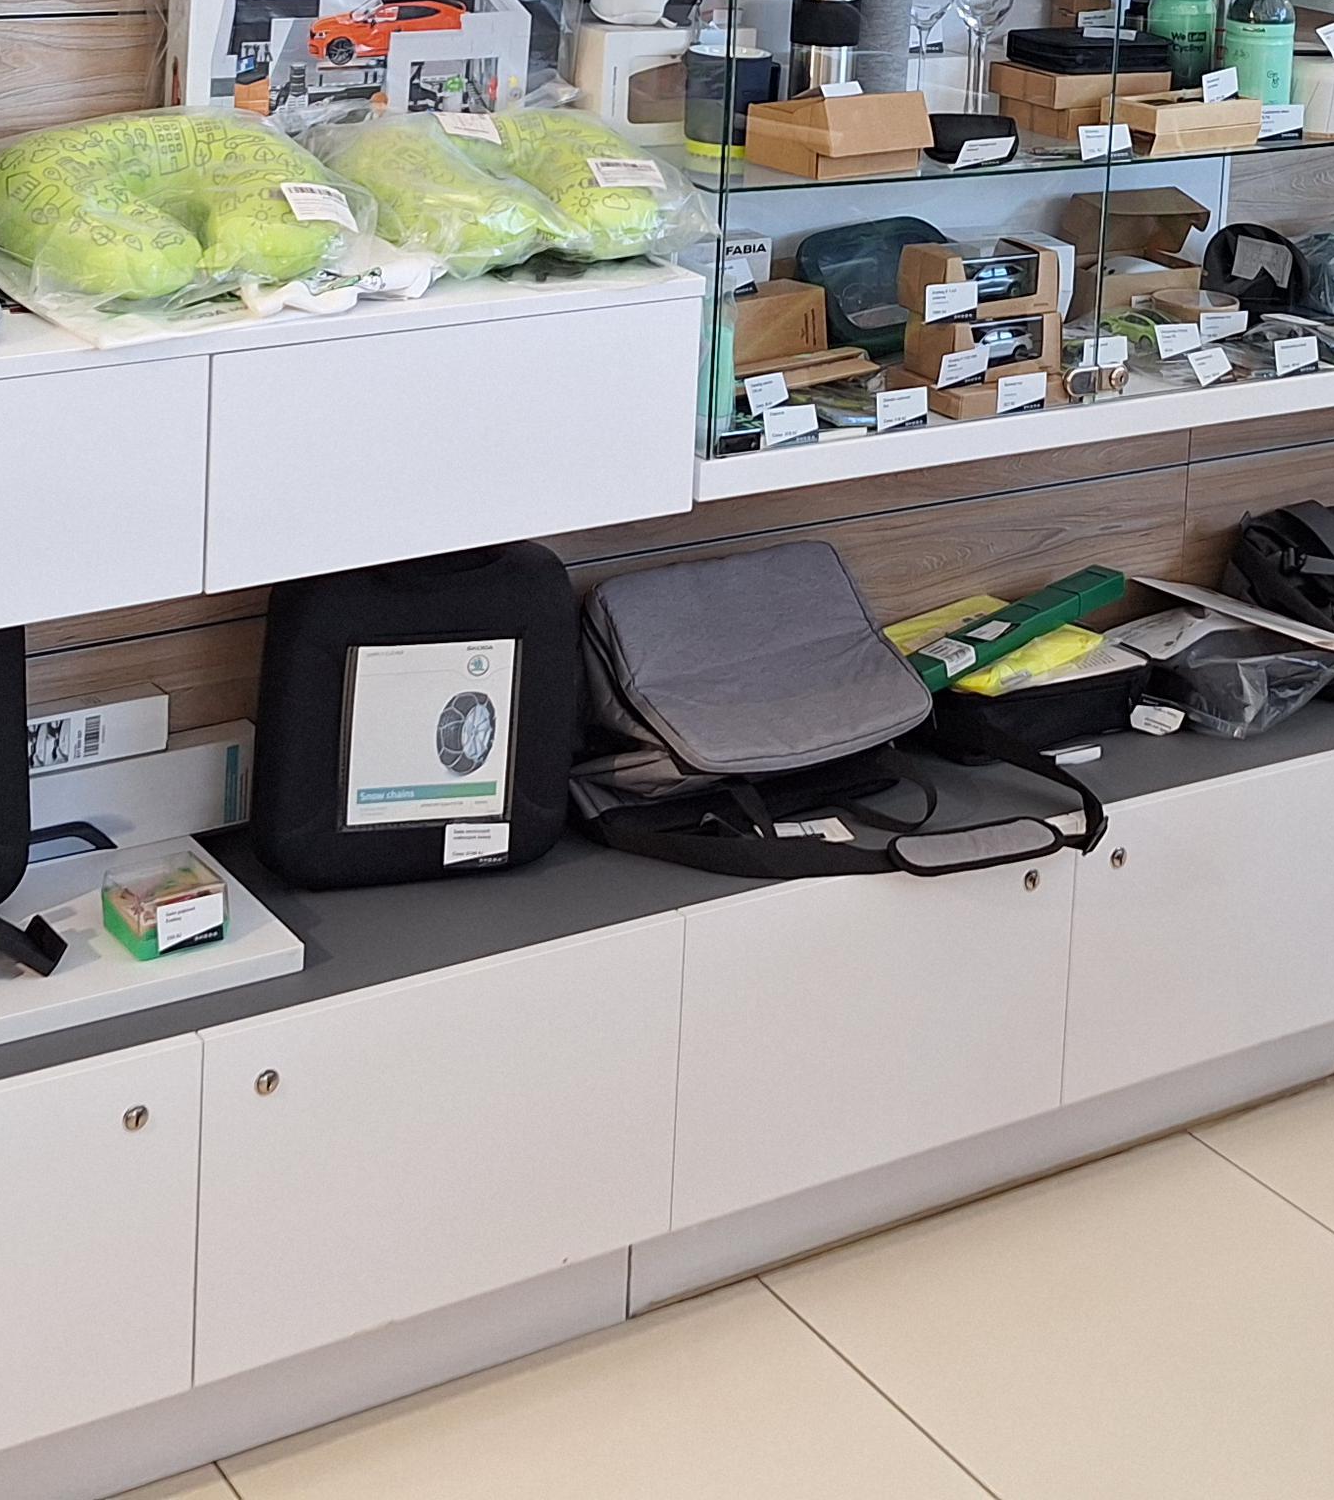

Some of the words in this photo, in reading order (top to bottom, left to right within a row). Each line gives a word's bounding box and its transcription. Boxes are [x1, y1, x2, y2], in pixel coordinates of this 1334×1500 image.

[1171, 31, 1186, 41] We
[1172, 43, 1204, 53] Cycling
[725, 243, 767, 256] FABIA
[359, 790, 385, 801] Snow
[386, 789, 415, 799] chains
